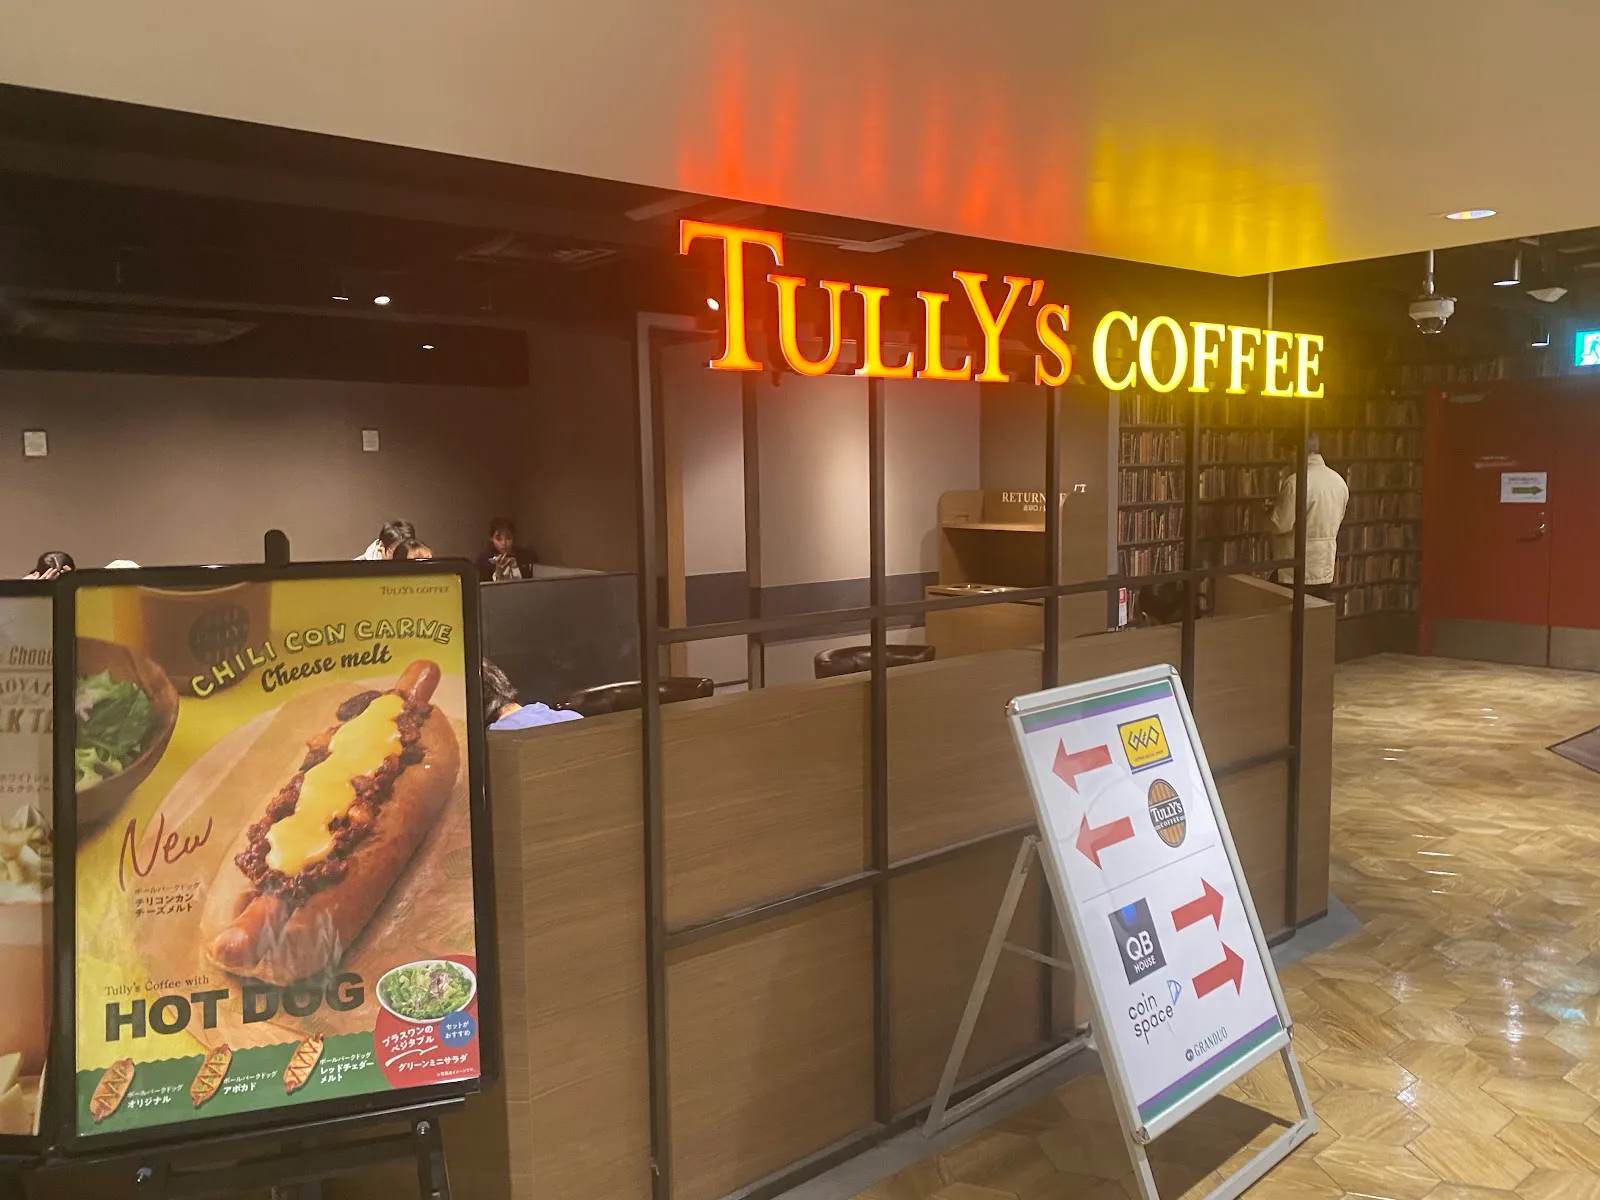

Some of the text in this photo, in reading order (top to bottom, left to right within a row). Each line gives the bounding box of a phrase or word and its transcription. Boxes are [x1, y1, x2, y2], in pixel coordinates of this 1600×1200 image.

[1093, 309, 1325, 398] COFFEE
[1002, 492, 1046, 503] RETURN
[190, 642, 277, 698] CHILI
[285, 622, 346, 652] CON
[355, 617, 452, 645] CARNE
[261, 643, 392, 692] Cheese melt
[119, 813, 212, 891] New
[1126, 930, 1154, 961] QB
[1133, 956, 1156, 973] HOUSE
[104, 975, 210, 997] Tully's Coffee with
[105, 972, 365, 1042] HOT DOG
[1128, 992, 1158, 1020] coin
[444, 1030, 471, 1039] おすすめ
[1134, 1004, 1174, 1045] space
[382, 1025, 434, 1046] プラスワンの
[391, 1036, 435, 1052] ベジタブル
[1193, 1027, 1228, 1057] GRANDUO
[320, 1060, 375, 1075] レッドチェダー
[398, 1053, 469, 1072] グリーンミニサラダ
[223, 1082, 257, 1095] アボカド
[320, 1073, 344, 1084] メルト
[127, 1095, 172, 1109] オリジナル
